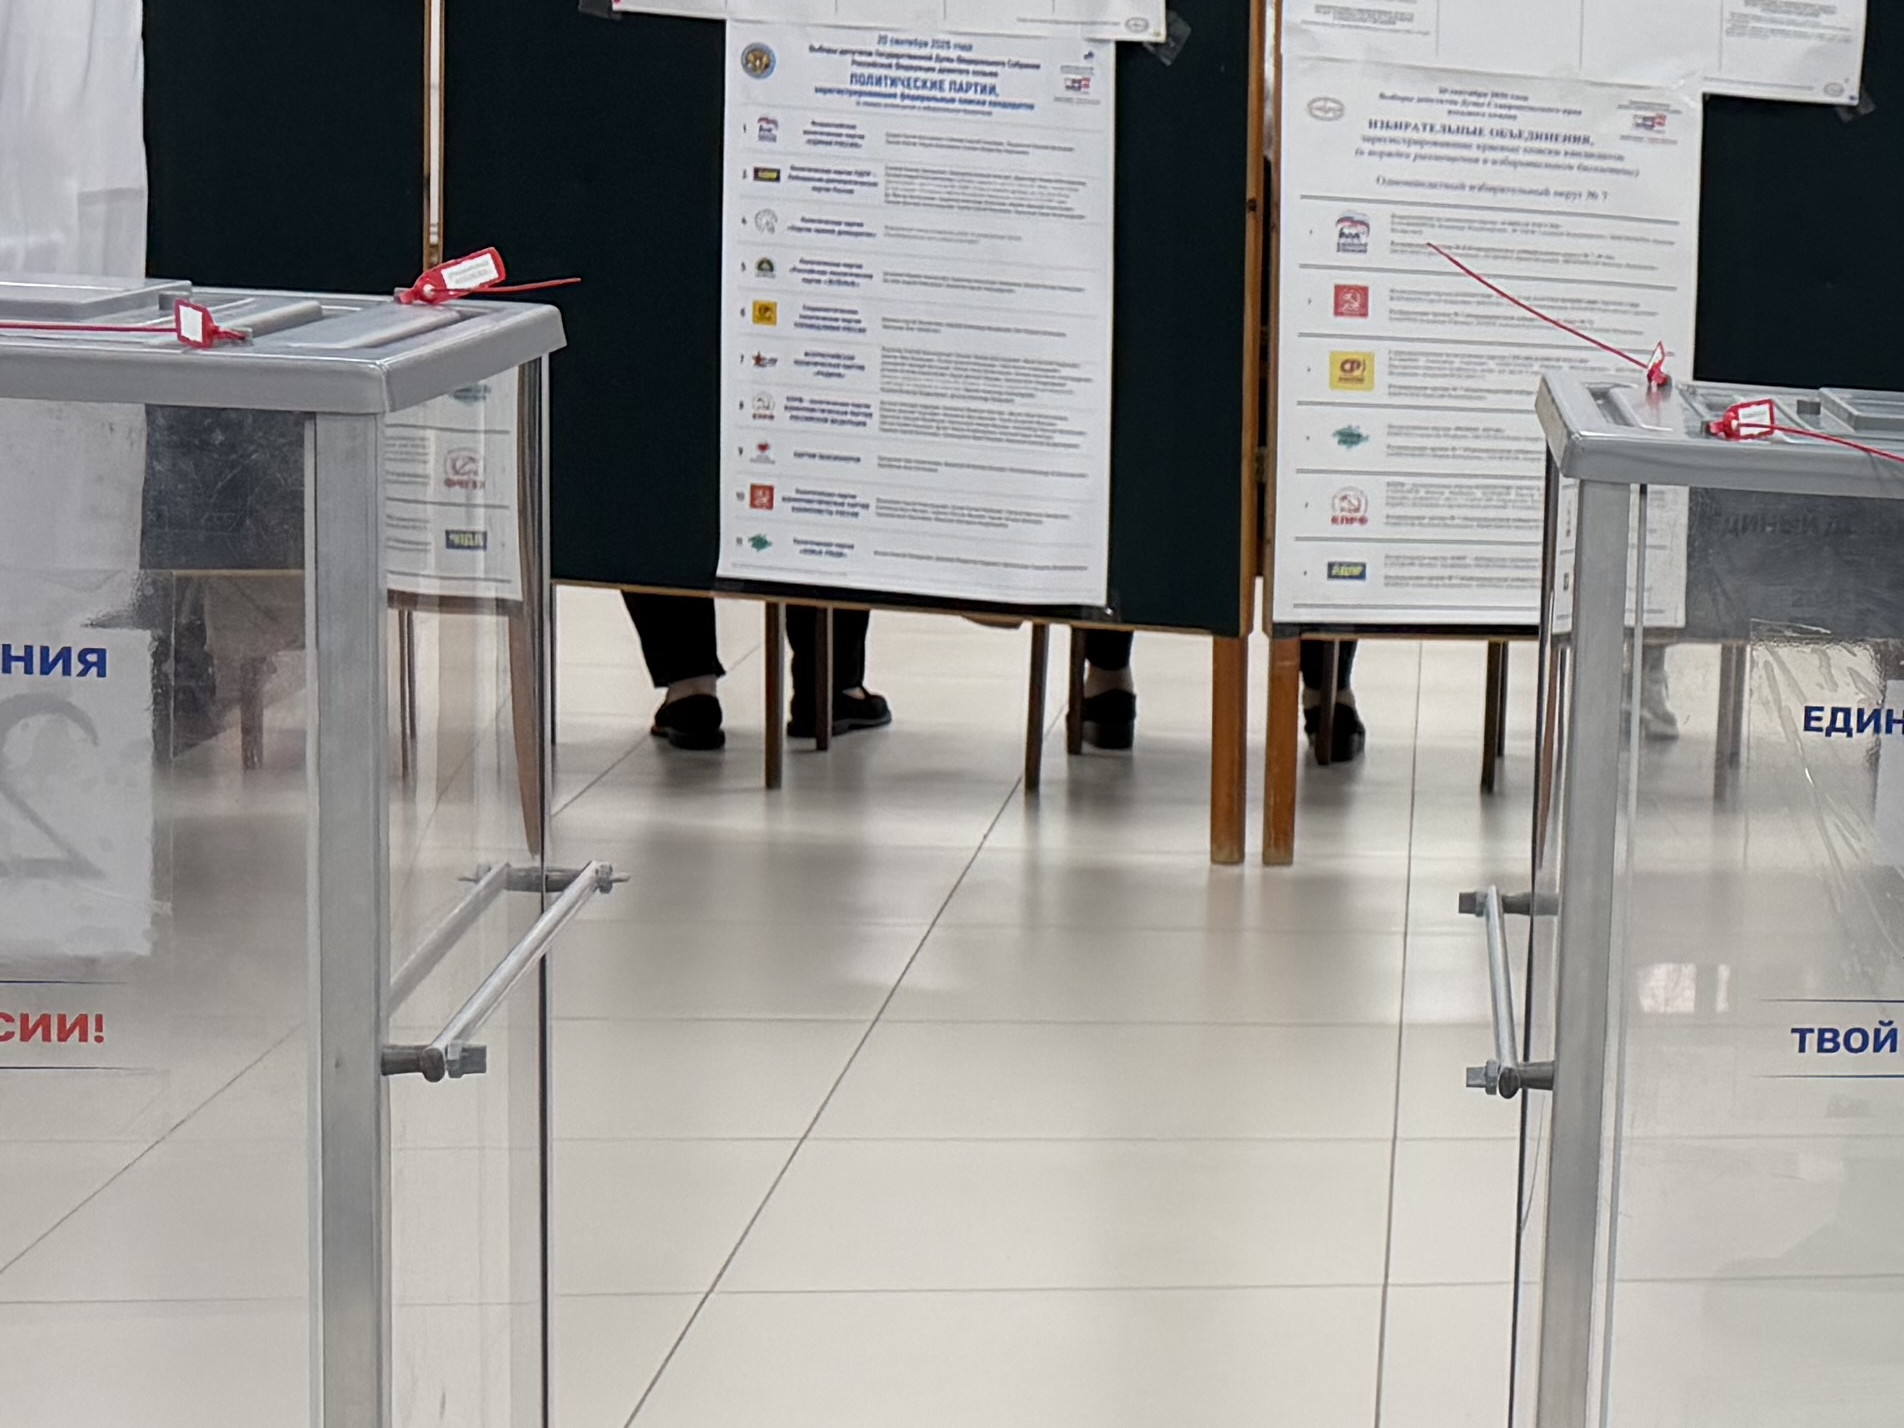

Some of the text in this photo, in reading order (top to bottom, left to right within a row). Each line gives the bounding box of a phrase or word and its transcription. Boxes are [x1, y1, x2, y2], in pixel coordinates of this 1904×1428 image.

[850, 72, 999, 98] ПОЛИТИЧЕСКИЕ ПАРТИИ,
[1368, 118, 1483, 137] ИЗБИРАТЕЛЬНЫЕ
[1791, 1021, 1898, 1053] ТВОЙ
